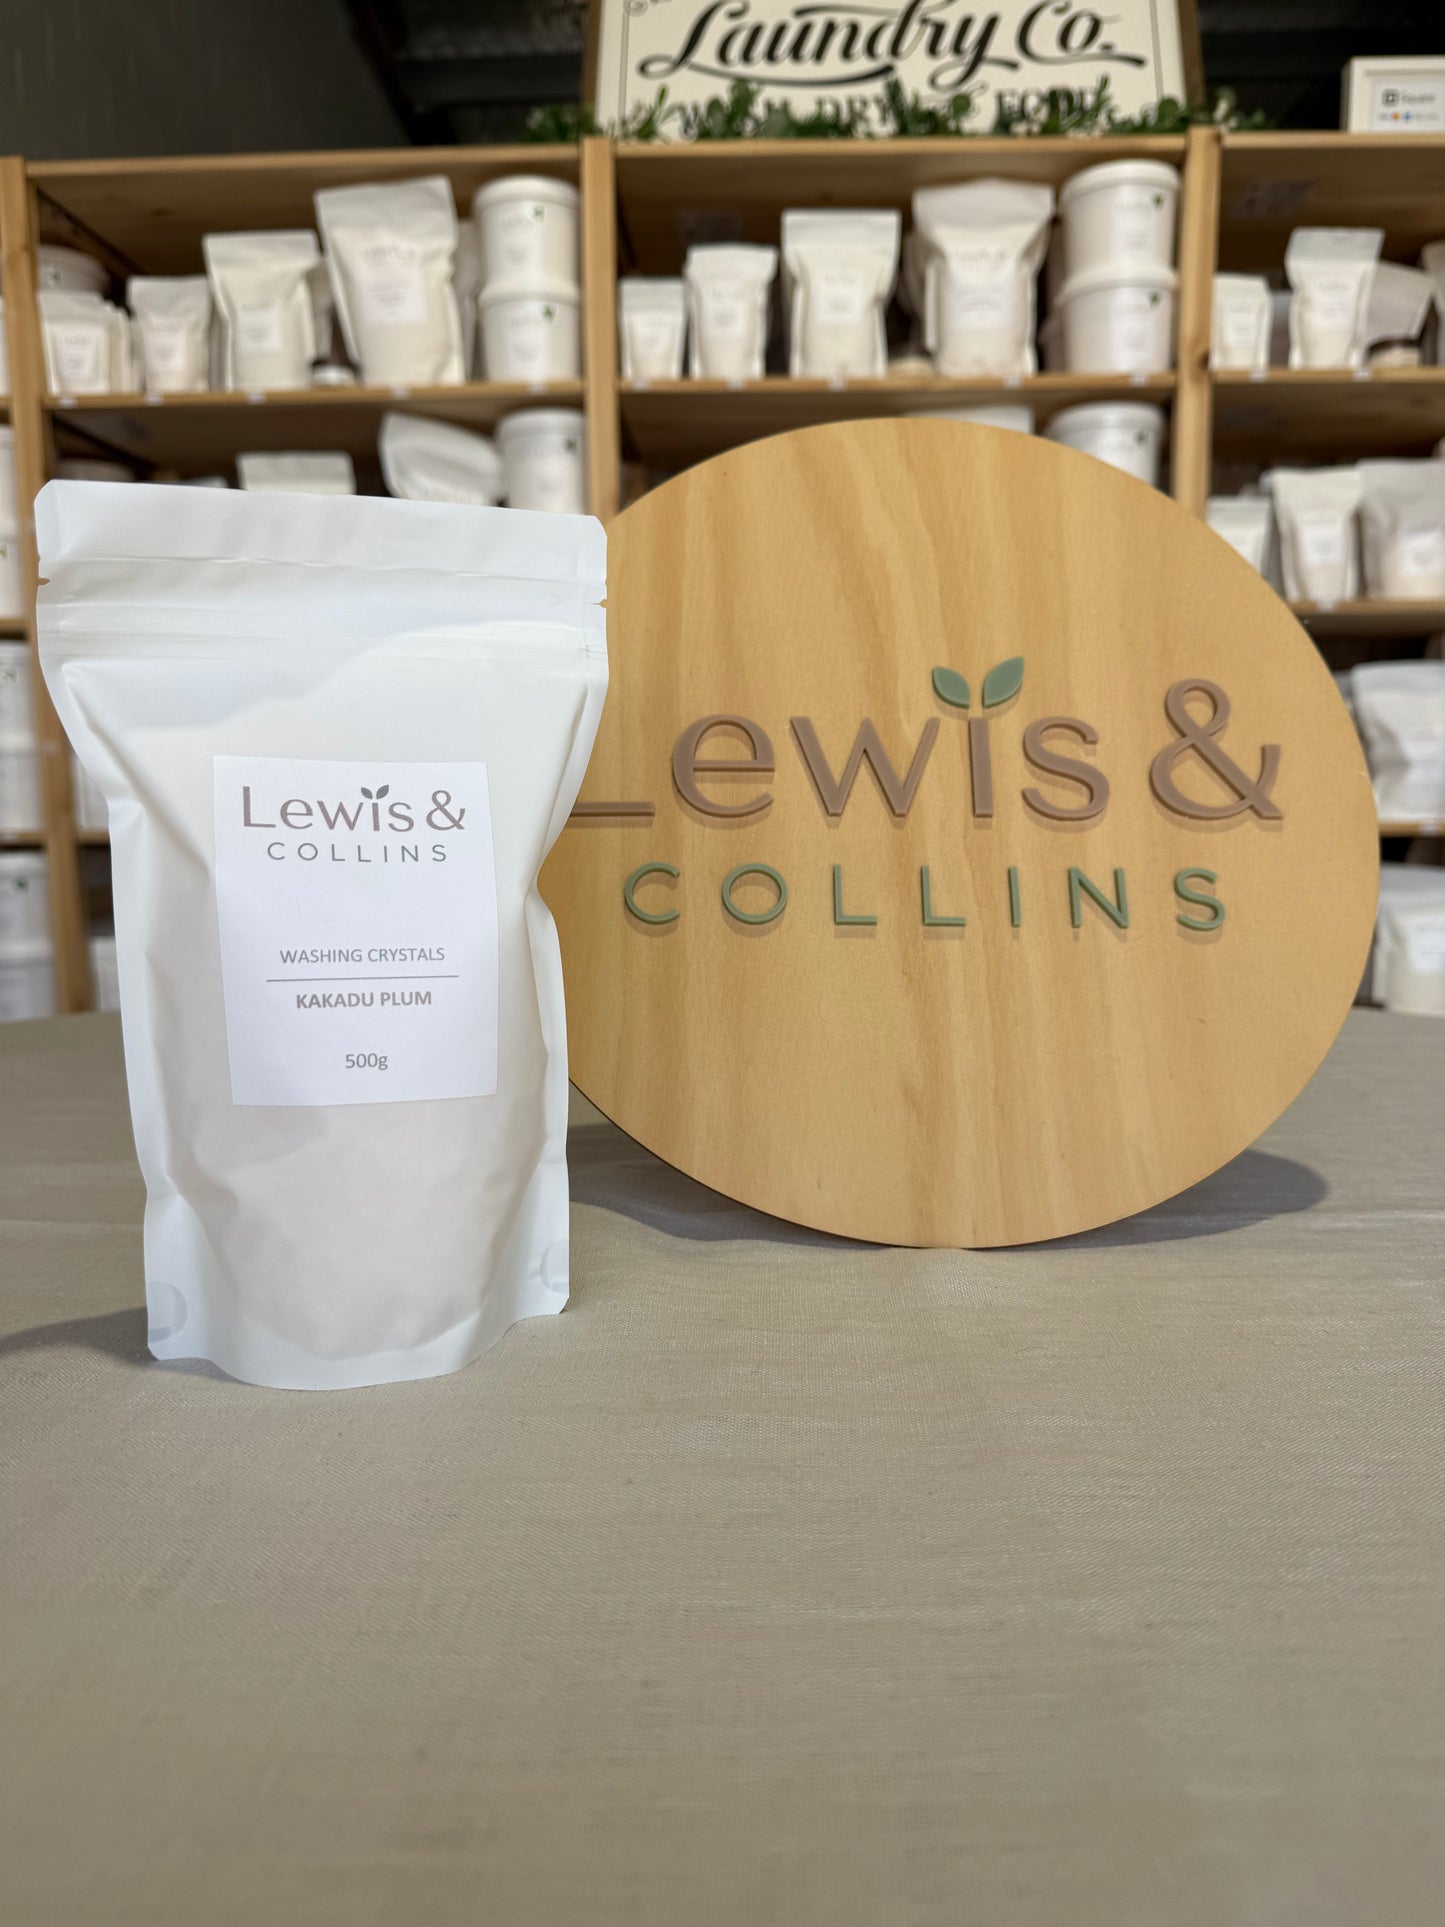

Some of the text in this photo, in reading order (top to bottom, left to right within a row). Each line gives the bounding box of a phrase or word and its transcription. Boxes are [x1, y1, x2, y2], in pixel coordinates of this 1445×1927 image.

[637, 0, 1147, 92] Laundry Co.
[569, 657, 1284, 823] ewis &
[242, 785, 466, 832] Lewis &
[267, 842, 448, 863] COLLINS
[623, 861, 1228, 932] COLLINS
[280, 947, 446, 964] WASHING CRYSTALS
[296, 991, 433, 1009] KAKADU PLUM
[345, 1053, 389, 1071] 500g
